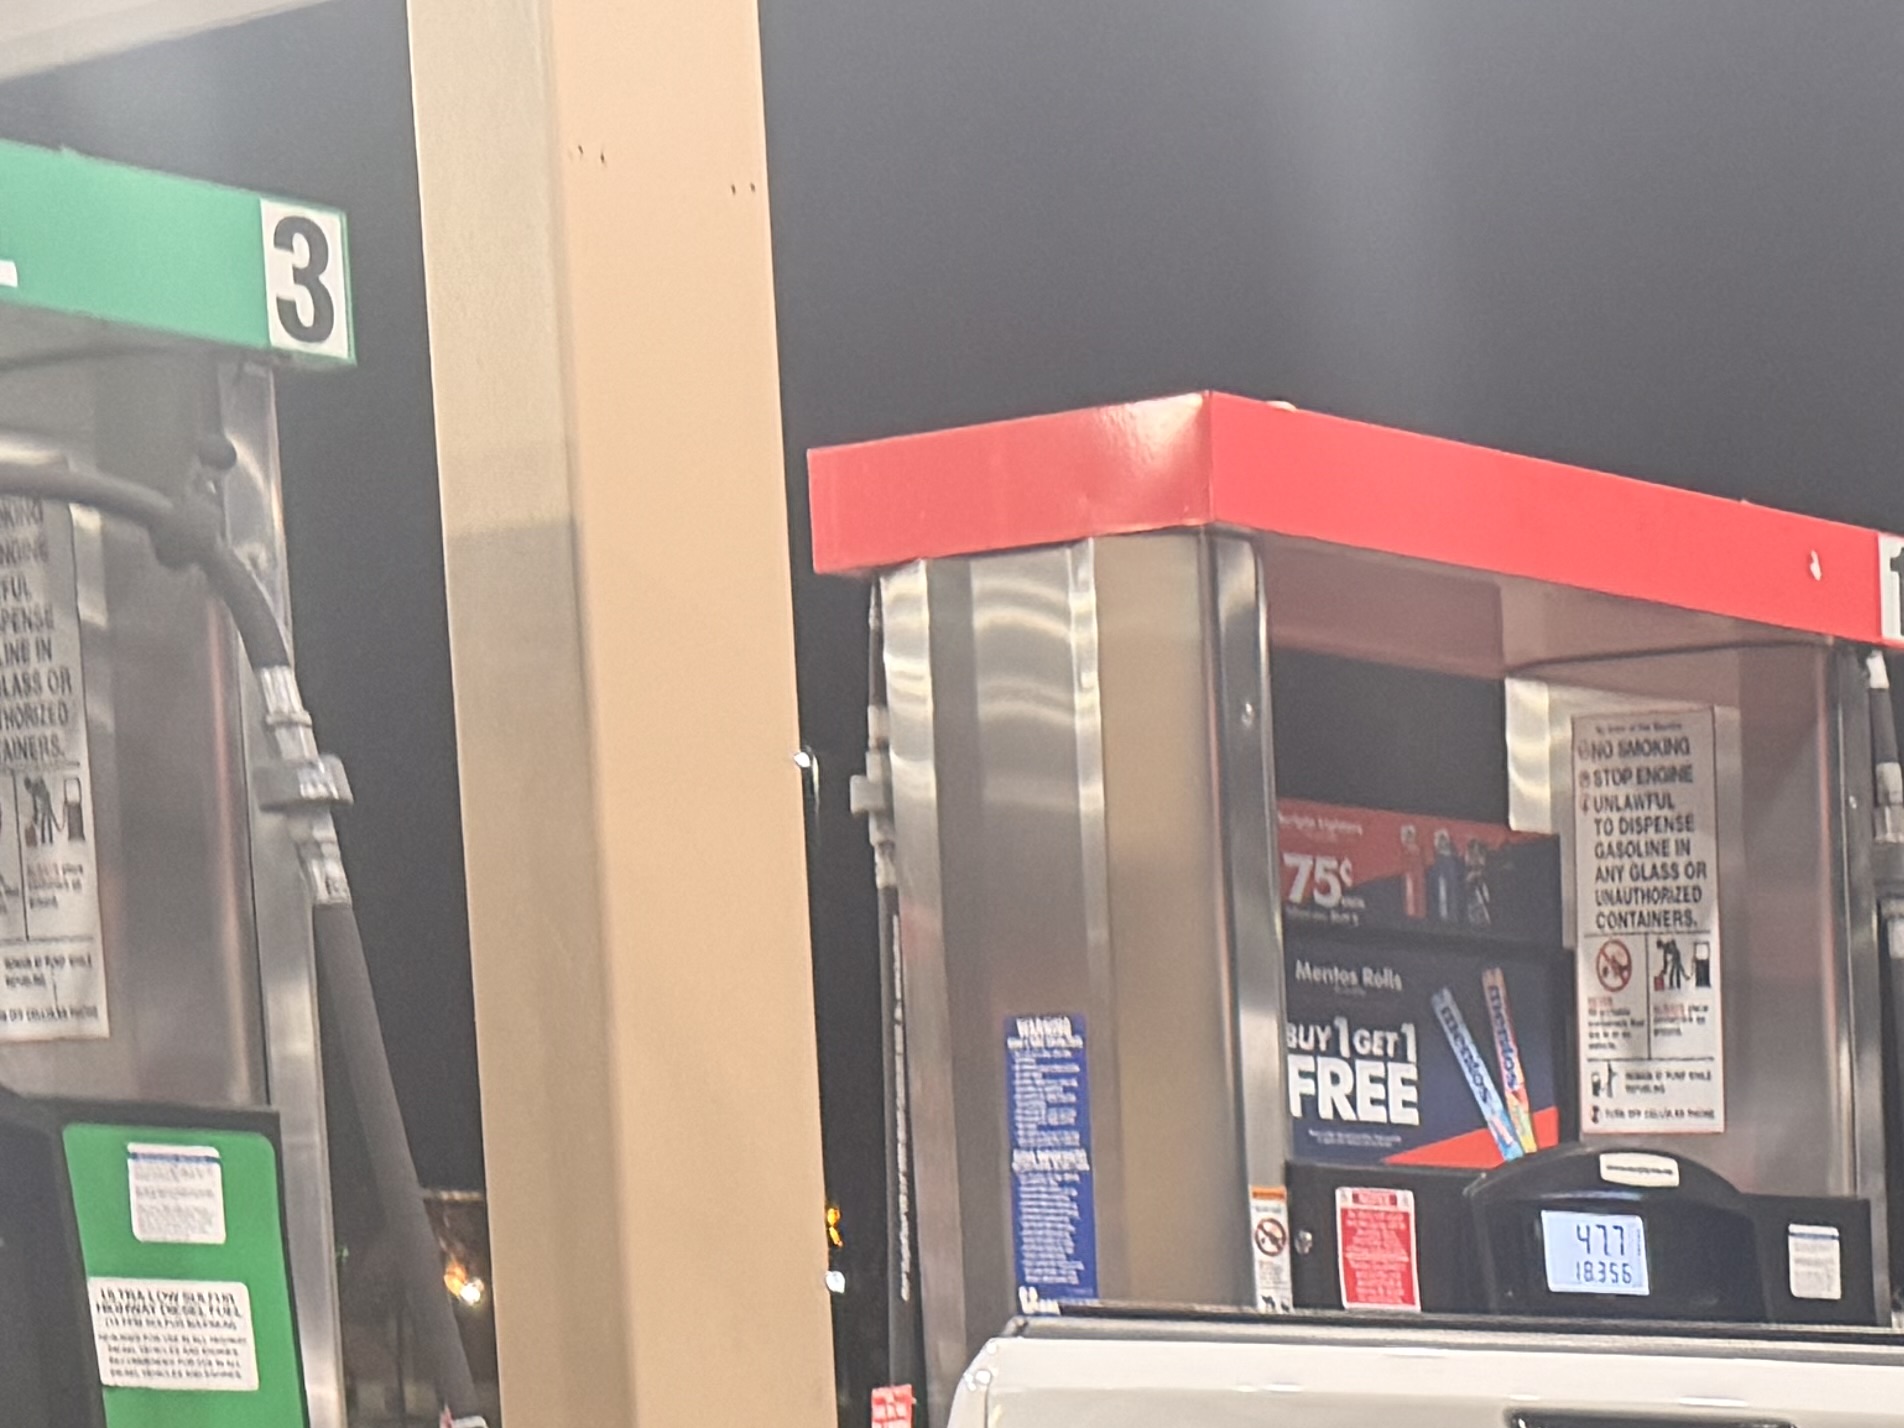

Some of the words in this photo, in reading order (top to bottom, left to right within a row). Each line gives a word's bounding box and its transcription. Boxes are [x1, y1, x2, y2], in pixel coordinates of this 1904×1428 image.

[273, 216, 335, 343] 3
[0, 671, 42, 698] LASS
[48, 666, 72, 694] OR
[1591, 739, 1613, 761] NO
[1618, 736, 1691, 759] SMOKING
[1593, 765, 1633, 787] STOP
[1636, 764, 1694, 786] ENGINE
[1593, 793, 1676, 813] UNLAWFUL
[1593, 818, 1614, 837] TO
[1619, 814, 1695, 836] DISPENSE
[1594, 838, 1670, 860] GASOLINE
[1675, 838, 1691, 857] IN
[1595, 864, 1625, 884] ANY
[1629, 861, 1680, 882] GLASS
[1684, 861, 1707, 880] OR
[1595, 886, 1702, 907] UNAUTHORIZED
[1296, 960, 1358, 986] Mentos
[1363, 966, 1403, 991] Rolls
[1286, 1022, 1331, 1051] BUY
[1334, 1016, 1350, 1058] 1
[1353, 1029, 1399, 1057] GET
[1401, 1022, 1417, 1062] 1
[1287, 1054, 1420, 1126] FREE
